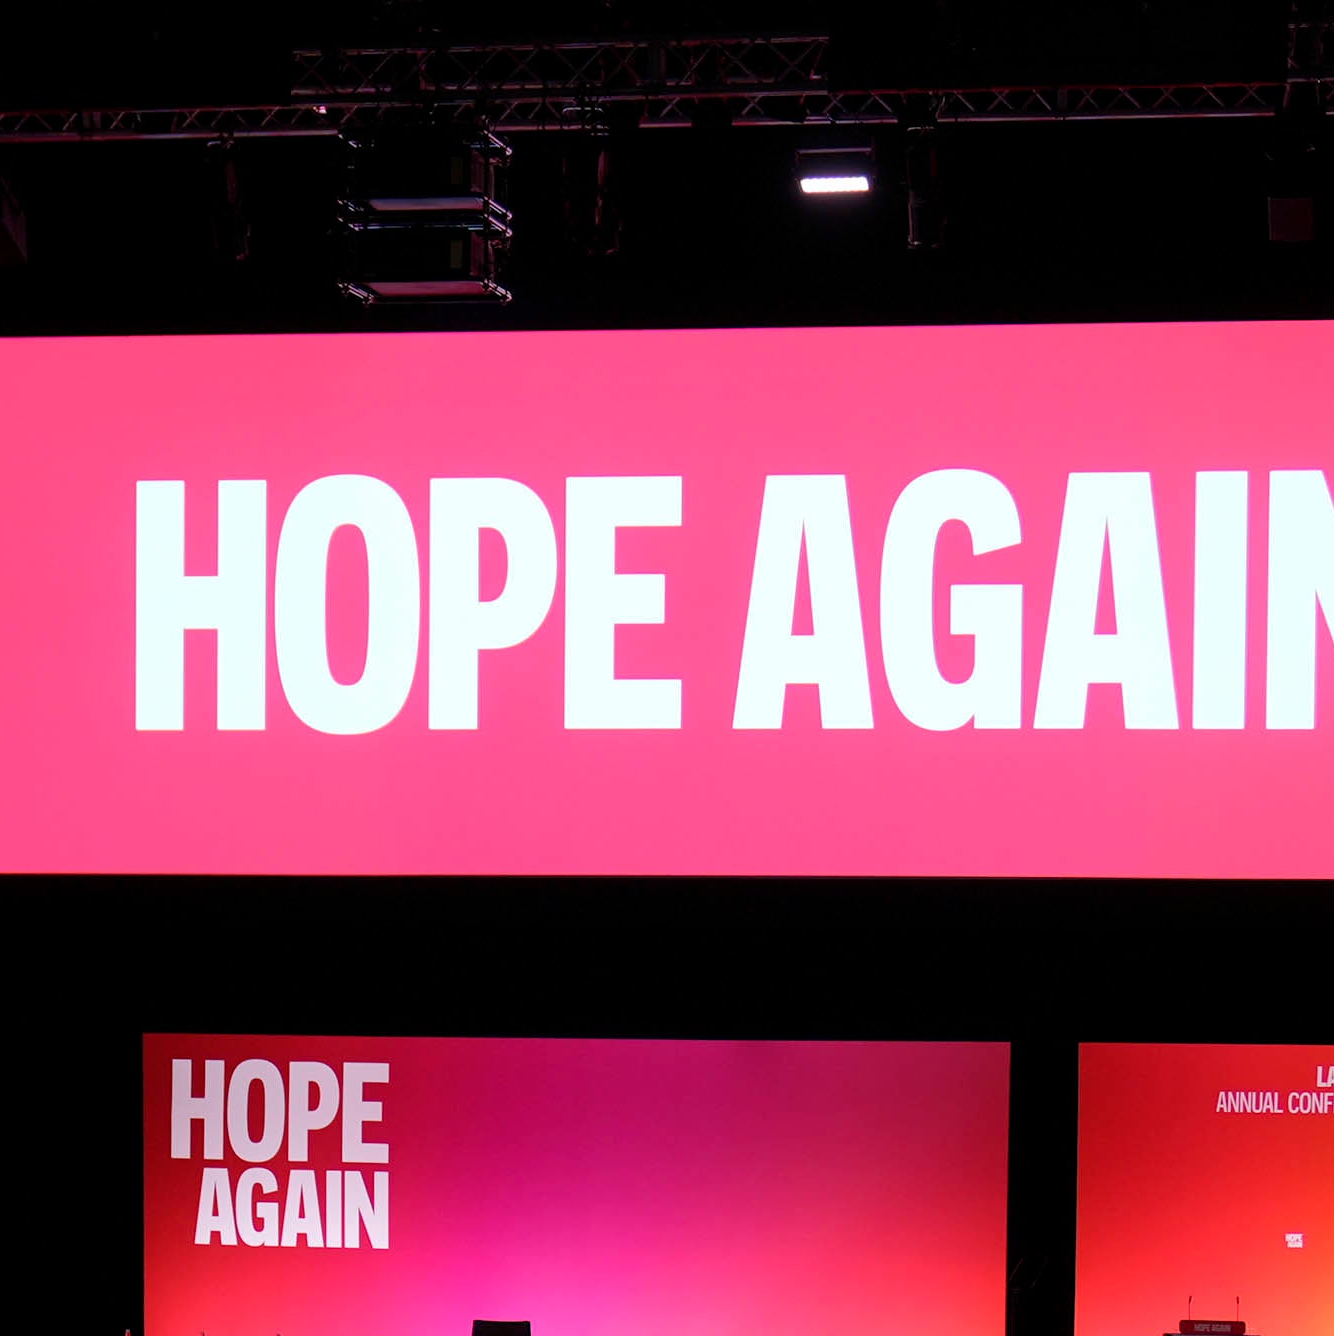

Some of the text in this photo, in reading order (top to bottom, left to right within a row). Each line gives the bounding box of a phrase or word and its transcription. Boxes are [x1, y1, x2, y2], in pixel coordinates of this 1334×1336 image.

[136, 472, 684, 737] HOPE
[171, 1058, 390, 1164] HOPE
[1216, 1091, 1284, 1114] ANNUAL
[194, 1167, 390, 1251] AGAIN
